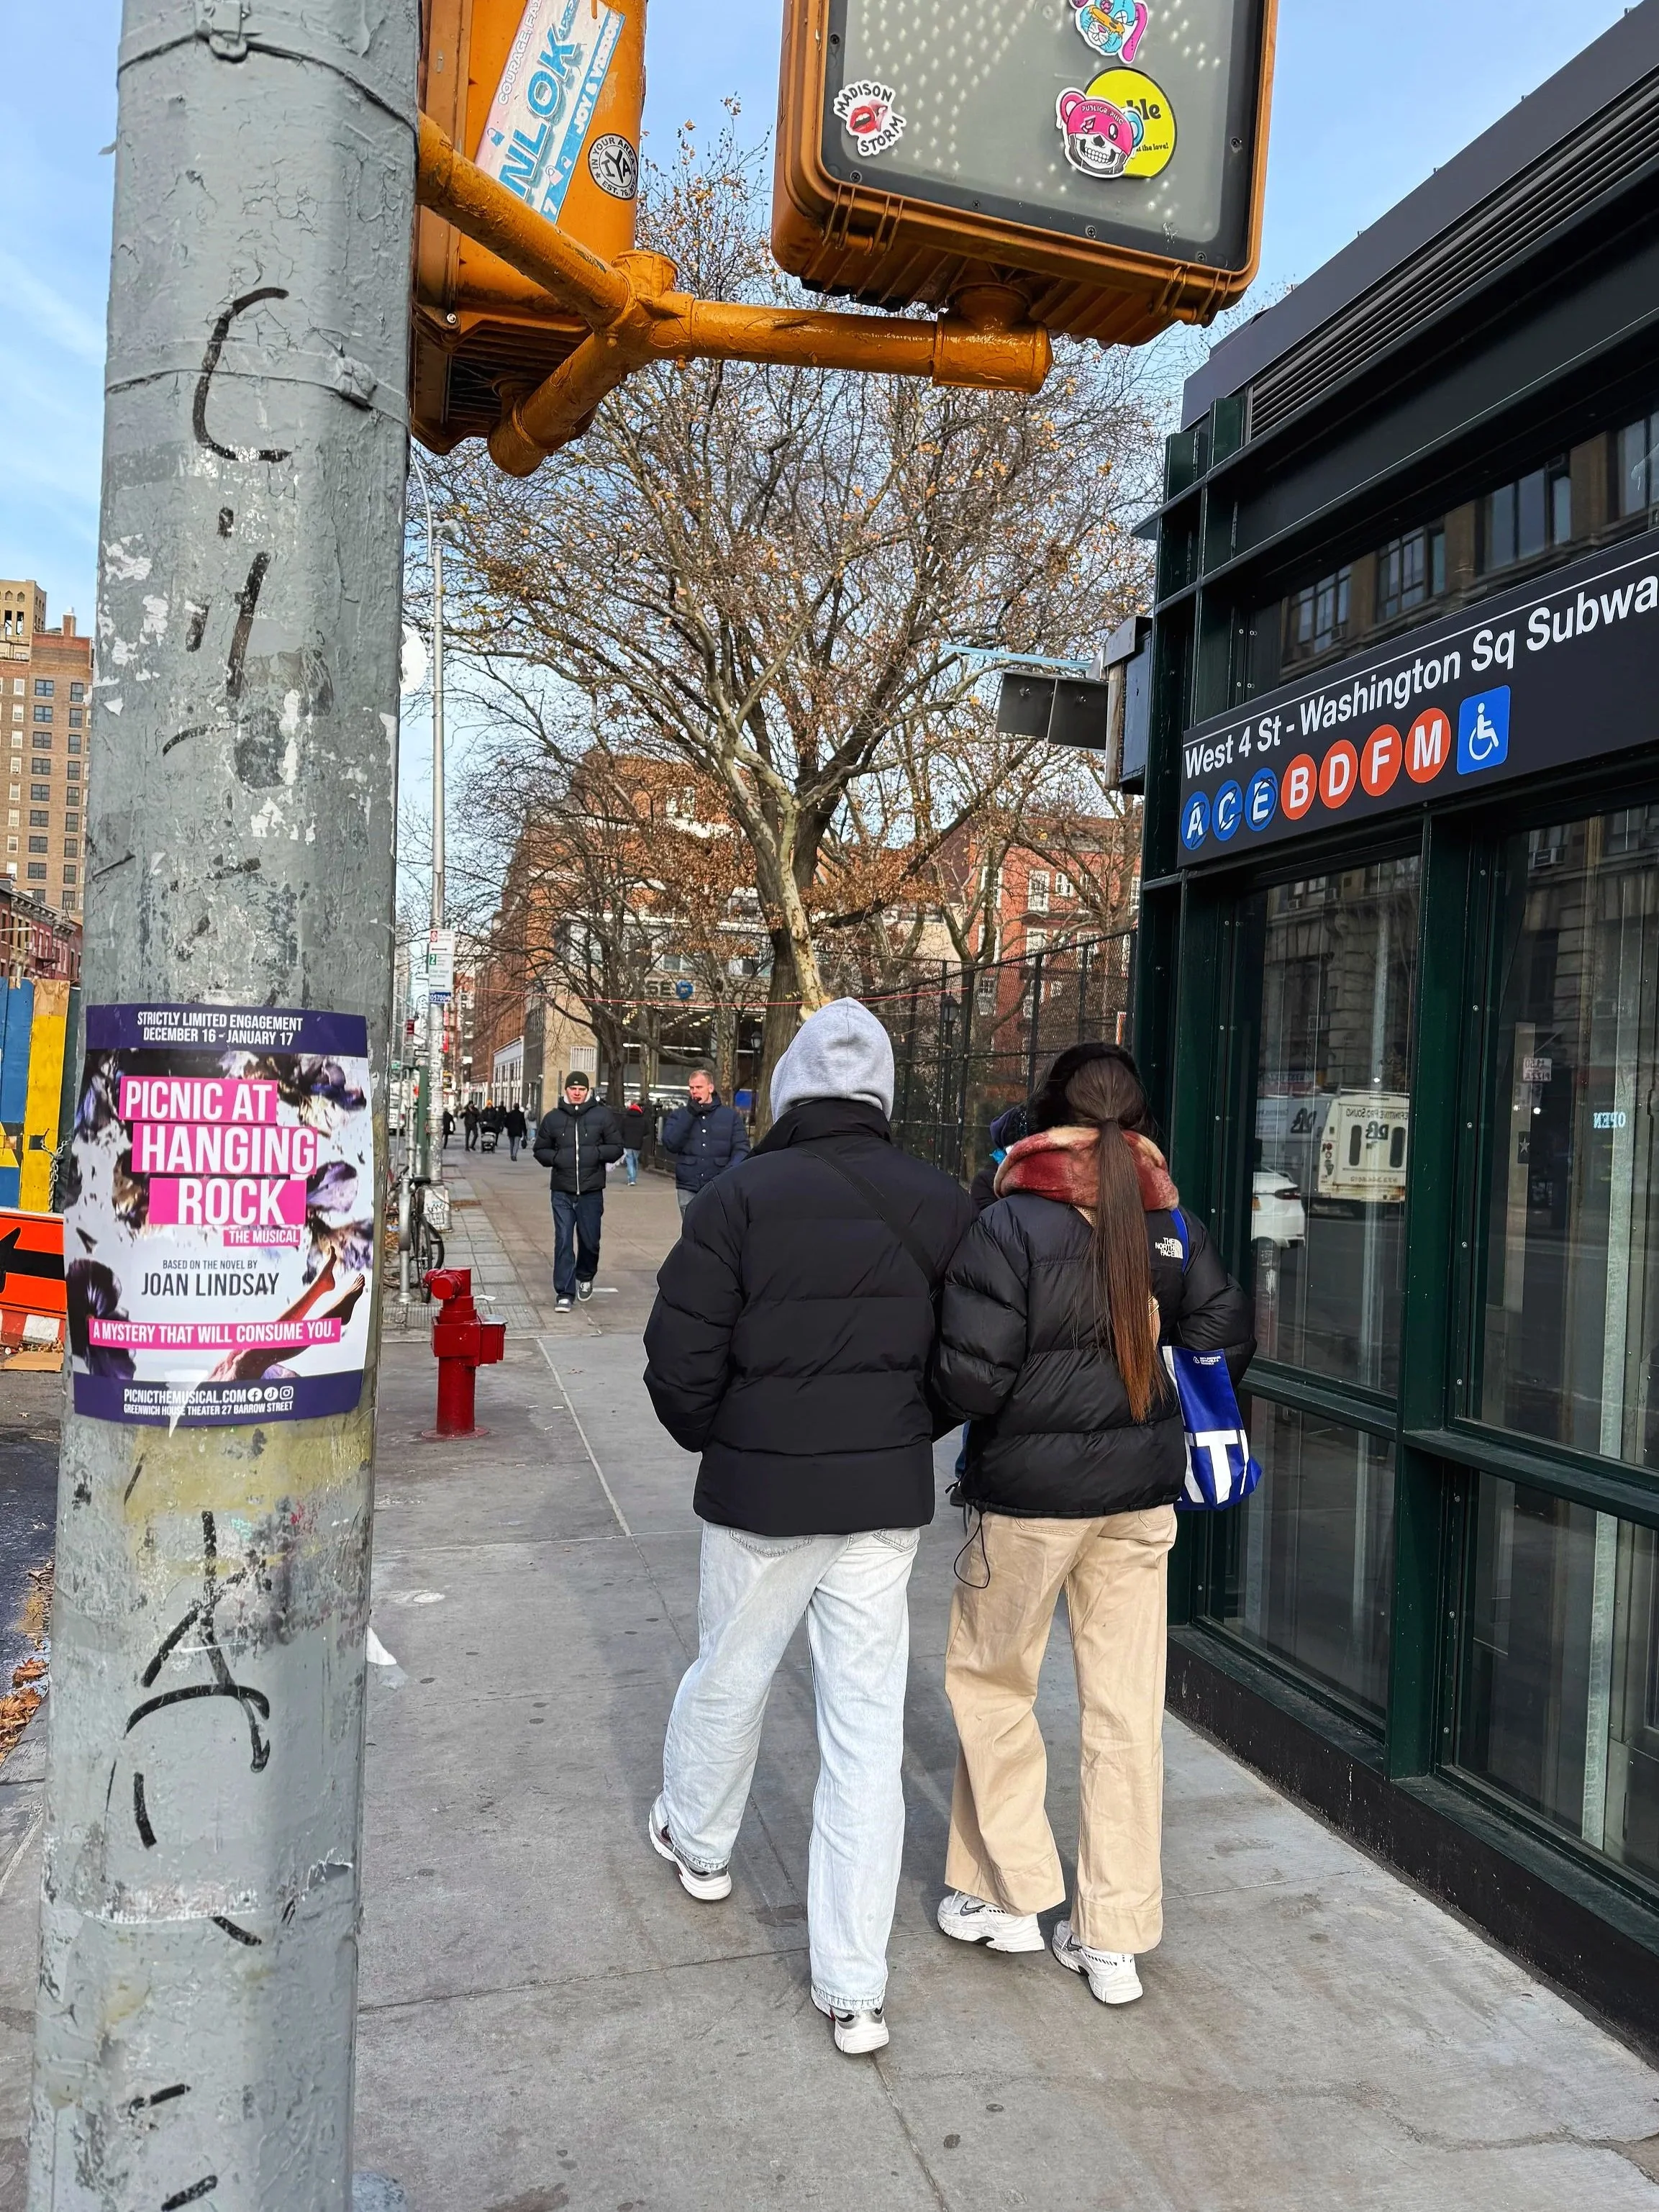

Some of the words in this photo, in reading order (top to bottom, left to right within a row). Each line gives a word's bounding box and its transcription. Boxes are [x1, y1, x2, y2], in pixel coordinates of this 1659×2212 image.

[499, 30, 532, 105] COURAGE,
[837, 83, 893, 117] MADISON
[498, 26, 577, 200] NLOK
[575, 100, 595, 133] JOY
[592, 137, 615, 155] YOUR
[860, 116, 904, 153] STORM
[617, 139, 635, 164] AREA
[591, 158, 599, 170] IN
[602, 180, 619, 194] EST.
[1185, 735, 1234, 779] West
[1238, 726, 1252, 758] 4
[1257, 715, 1282, 752] St
[1300, 651, 1460, 736] Washington
[1471, 630, 1515, 671] Sq
[1526, 575, 1659, 651] Subwa
[1186, 801, 1204, 840] A
[1218, 792, 1236, 831] C
[1253, 780, 1270, 822] E
[1289, 766, 1309, 809] B
[1328, 753, 1350, 798] D
[1371, 736, 1393, 784] F
[1413, 719, 1442, 771] M
[137, 1011, 180, 1025] STRICTLY
[182, 1012, 227, 1028] LIMITED
[229, 1014, 303, 1031] ENGAGEMENT
[143, 1027, 198, 1043] DECEMBER
[201, 1029, 216, 1043] 16
[226, 1030, 276, 1044] JANUARY
[280, 1032, 294, 1046] 17
[125, 1080, 222, 1120] PICNIC
[231, 1083, 272, 1121] AT
[142, 1126, 315, 1174] HANGING
[177, 1179, 287, 1225] ROCK
[229, 1230, 250, 1243] THE
[253, 1229, 299, 1244] MUSICAL
[1155, 1242, 1176, 1251] NORTH
[162, 1259, 187, 1269] BASED
[189, 1260, 201, 1269] ON
[203, 1260, 218, 1269] THE
[219, 1260, 245, 1269] NOVEL
[247, 1260, 258, 1269] BY
[142, 1273, 188, 1297] JOAN
[196, 1273, 280, 1296] LINDSAY
[93, 1326, 100, 1338] A
[102, 1325, 156, 1343] MYSTERY
[160, 1327, 193, 1343] THAT
[197, 1326, 232, 1343] WILL
[236, 1323, 304, 1343] CONSUME
[308, 1320, 335, 1339] YOU.
[124, 1388, 247, 1404] PICNICTHEMUSICAL.COM
[124, 1403, 160, 1415] GREENWICH
[161, 1405, 186, 1415] HOUSE
[187, 1405, 220, 1415] THEATER
[222, 1405, 232, 1415] 27
[233, 1404, 265, 1414] BARROW
[267, 1401, 294, 1413] STREET
